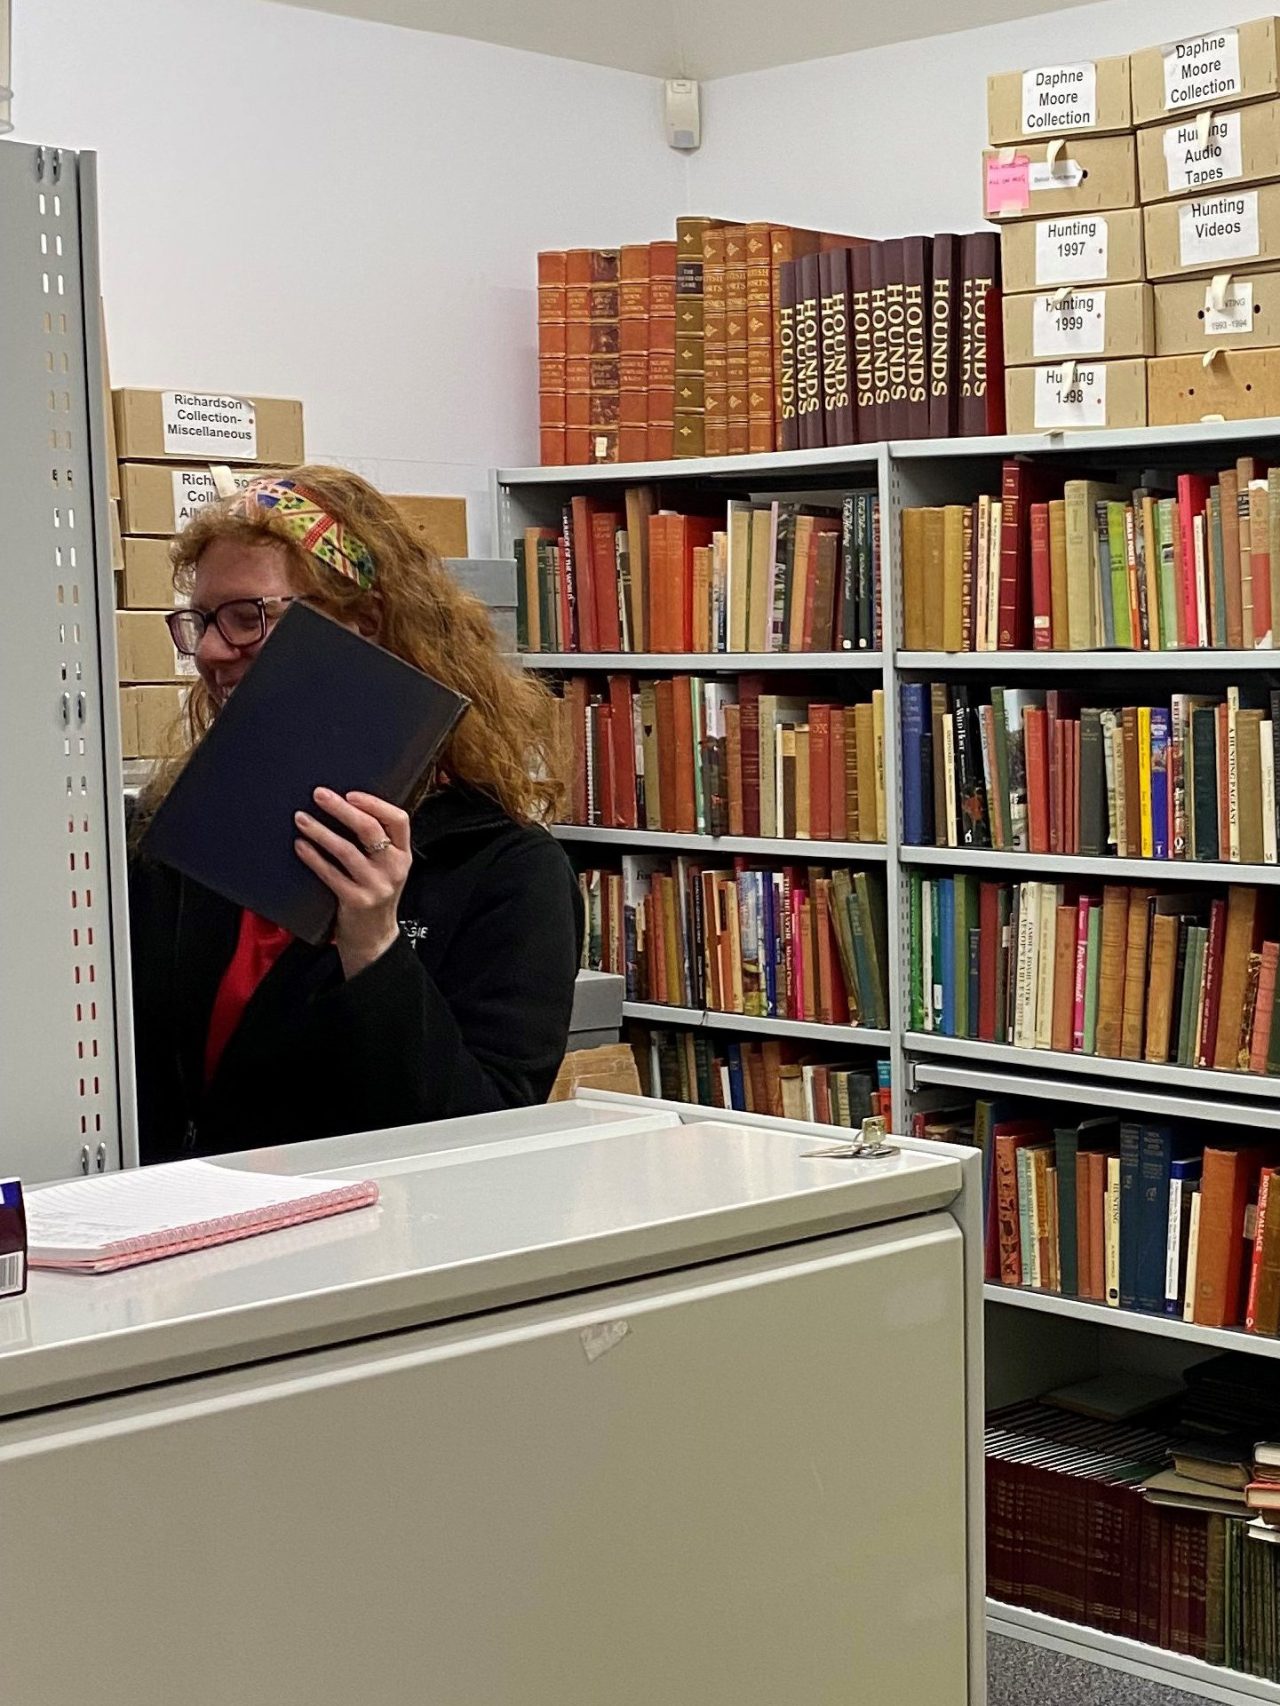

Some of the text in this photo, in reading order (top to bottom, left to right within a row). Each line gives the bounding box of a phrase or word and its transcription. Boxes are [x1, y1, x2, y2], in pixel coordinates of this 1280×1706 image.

[1176, 36, 1225, 59] Daphne
[1036, 70, 1083, 87] Daphne
[1181, 59, 1221, 80] Moore
[1039, 91, 1078, 107] Moore
[1171, 77, 1235, 103] Collection
[1027, 111, 1090, 128] Collection
[1184, 144, 1222, 164] Audio
[1185, 168, 1223, 185] Tapes
[1191, 198, 1245, 218] Hunting
[1048, 222, 1096, 238] Hunting
[1195, 221, 1241, 238] Videos
[1057, 242, 1086, 257] 1997
[1054, 316, 1083, 332] 1999
[872, 290, 889, 404] HOUNDS
[888, 284, 907, 400] HOUNDS
[905, 286, 925, 401] HOUNDS
[933, 280, 949, 395] HOUNDS
[975, 279, 992, 397] HOUNDS
[854, 292, 873, 406] HOUNDS
[174, 393, 242, 411] Richardson
[177, 409, 242, 426] Collection-
[167, 424, 252, 440] Miscellaneous
[1256, 1211, 1266, 1252] WALLACE
